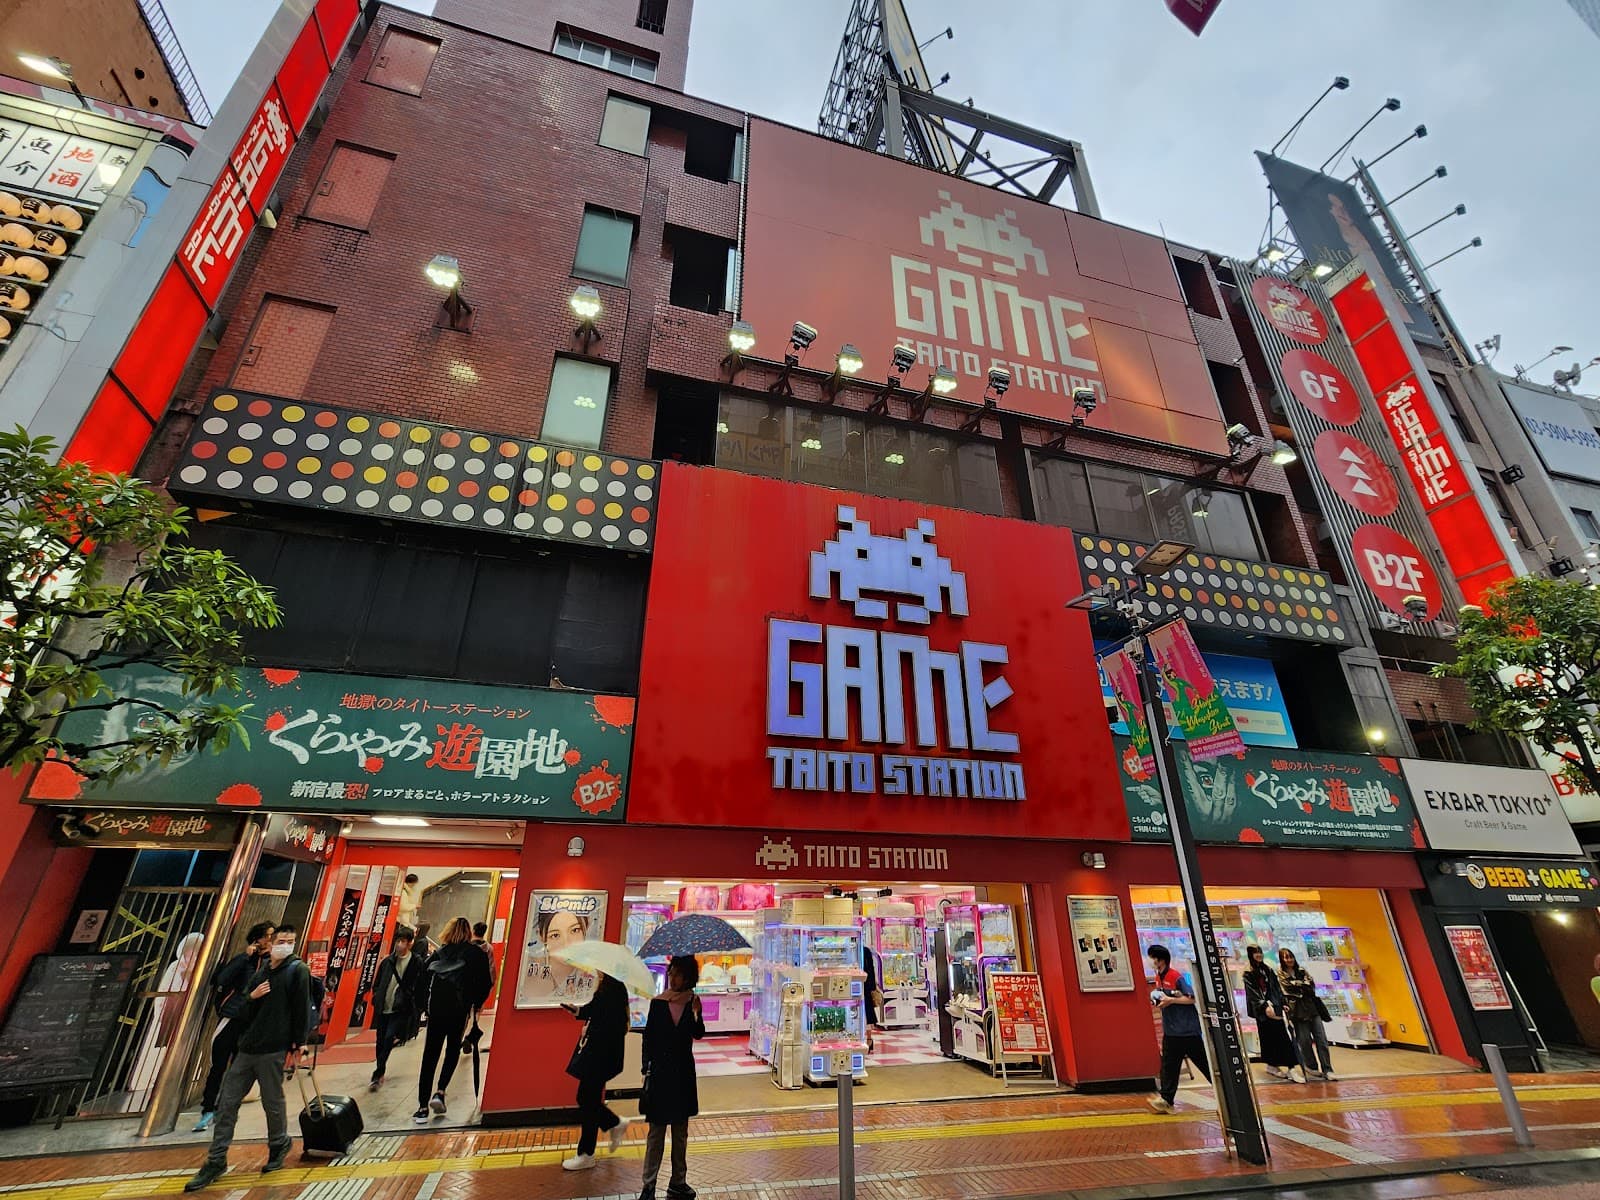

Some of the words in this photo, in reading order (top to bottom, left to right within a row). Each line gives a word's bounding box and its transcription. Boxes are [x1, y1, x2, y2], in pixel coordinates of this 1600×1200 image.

[48, 146, 96, 188] 地酒
[191, 128, 275, 285] GAME
[890, 254, 1099, 373] GAME
[1299, 370, 1341, 403] 6F
[1398, 401, 1455, 501] GAME
[1363, 549, 1425, 593] B2F
[766, 617, 1022, 754] GAME
[268, 709, 569, 781] くらやみ遊園地
[579, 779, 616, 805] B2F
[766, 746, 876, 793] TAITO
[882, 754, 1027, 801] STATION
[1251, 770, 1397, 817] くらやみ遊園地
[1424, 789, 1489, 813] EXBAR
[84, 811, 207, 837] くらやみ遊園地
[1484, 820, 1500, 830] Beer
[1507, 821, 1529, 831] Game
[803, 845, 861, 869] TAITO
[868, 846, 949, 870] STATION
[1232, 1056, 1243, 1083] st.
